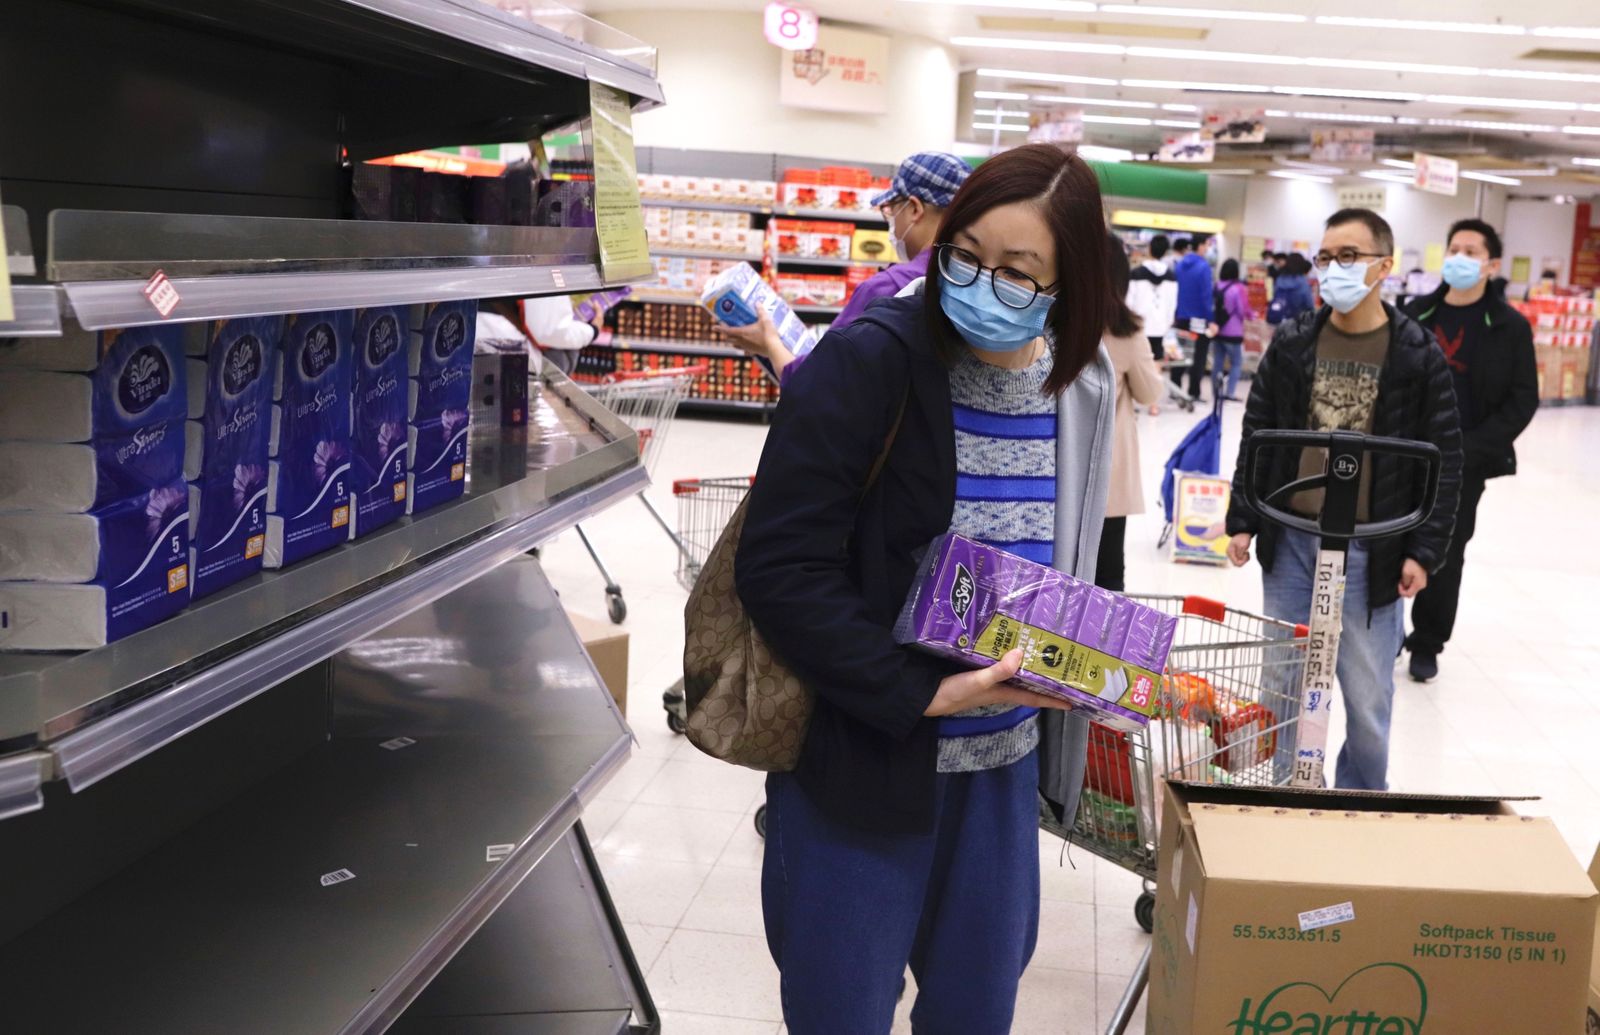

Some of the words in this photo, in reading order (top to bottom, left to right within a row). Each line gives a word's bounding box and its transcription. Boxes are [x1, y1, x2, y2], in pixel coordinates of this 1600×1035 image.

[779, 8, 801, 39] 8
[130, 377, 161, 398] Vinda
[297, 401, 315, 418] Ultra
[217, 421, 235, 440] Ultra
[116, 442, 136, 464] Ultra
[133, 425, 168, 454] Strong
[456, 442, 461, 455] 5
[395, 459, 401, 473] 5
[1338, 460, 1355, 473] BT
[337, 481, 344, 496] 5
[252, 508, 259, 524] 5
[172, 535, 180, 553] 5
[956, 576, 973, 605] Soft
[1316, 562, 1333, 616] 23:01
[992, 619, 1009, 657] UPGRADED
[1233, 925, 1341, 943] 55.5x33x51.5
[1419, 923, 1494, 942] Softpack
[1500, 927, 1556, 942] Tissue
[1413, 943, 1501, 960] HKDT3150
[1507, 947, 1523, 964] (5
[1528, 948, 1545, 961] IN
[1551, 948, 1567, 965] 1)
